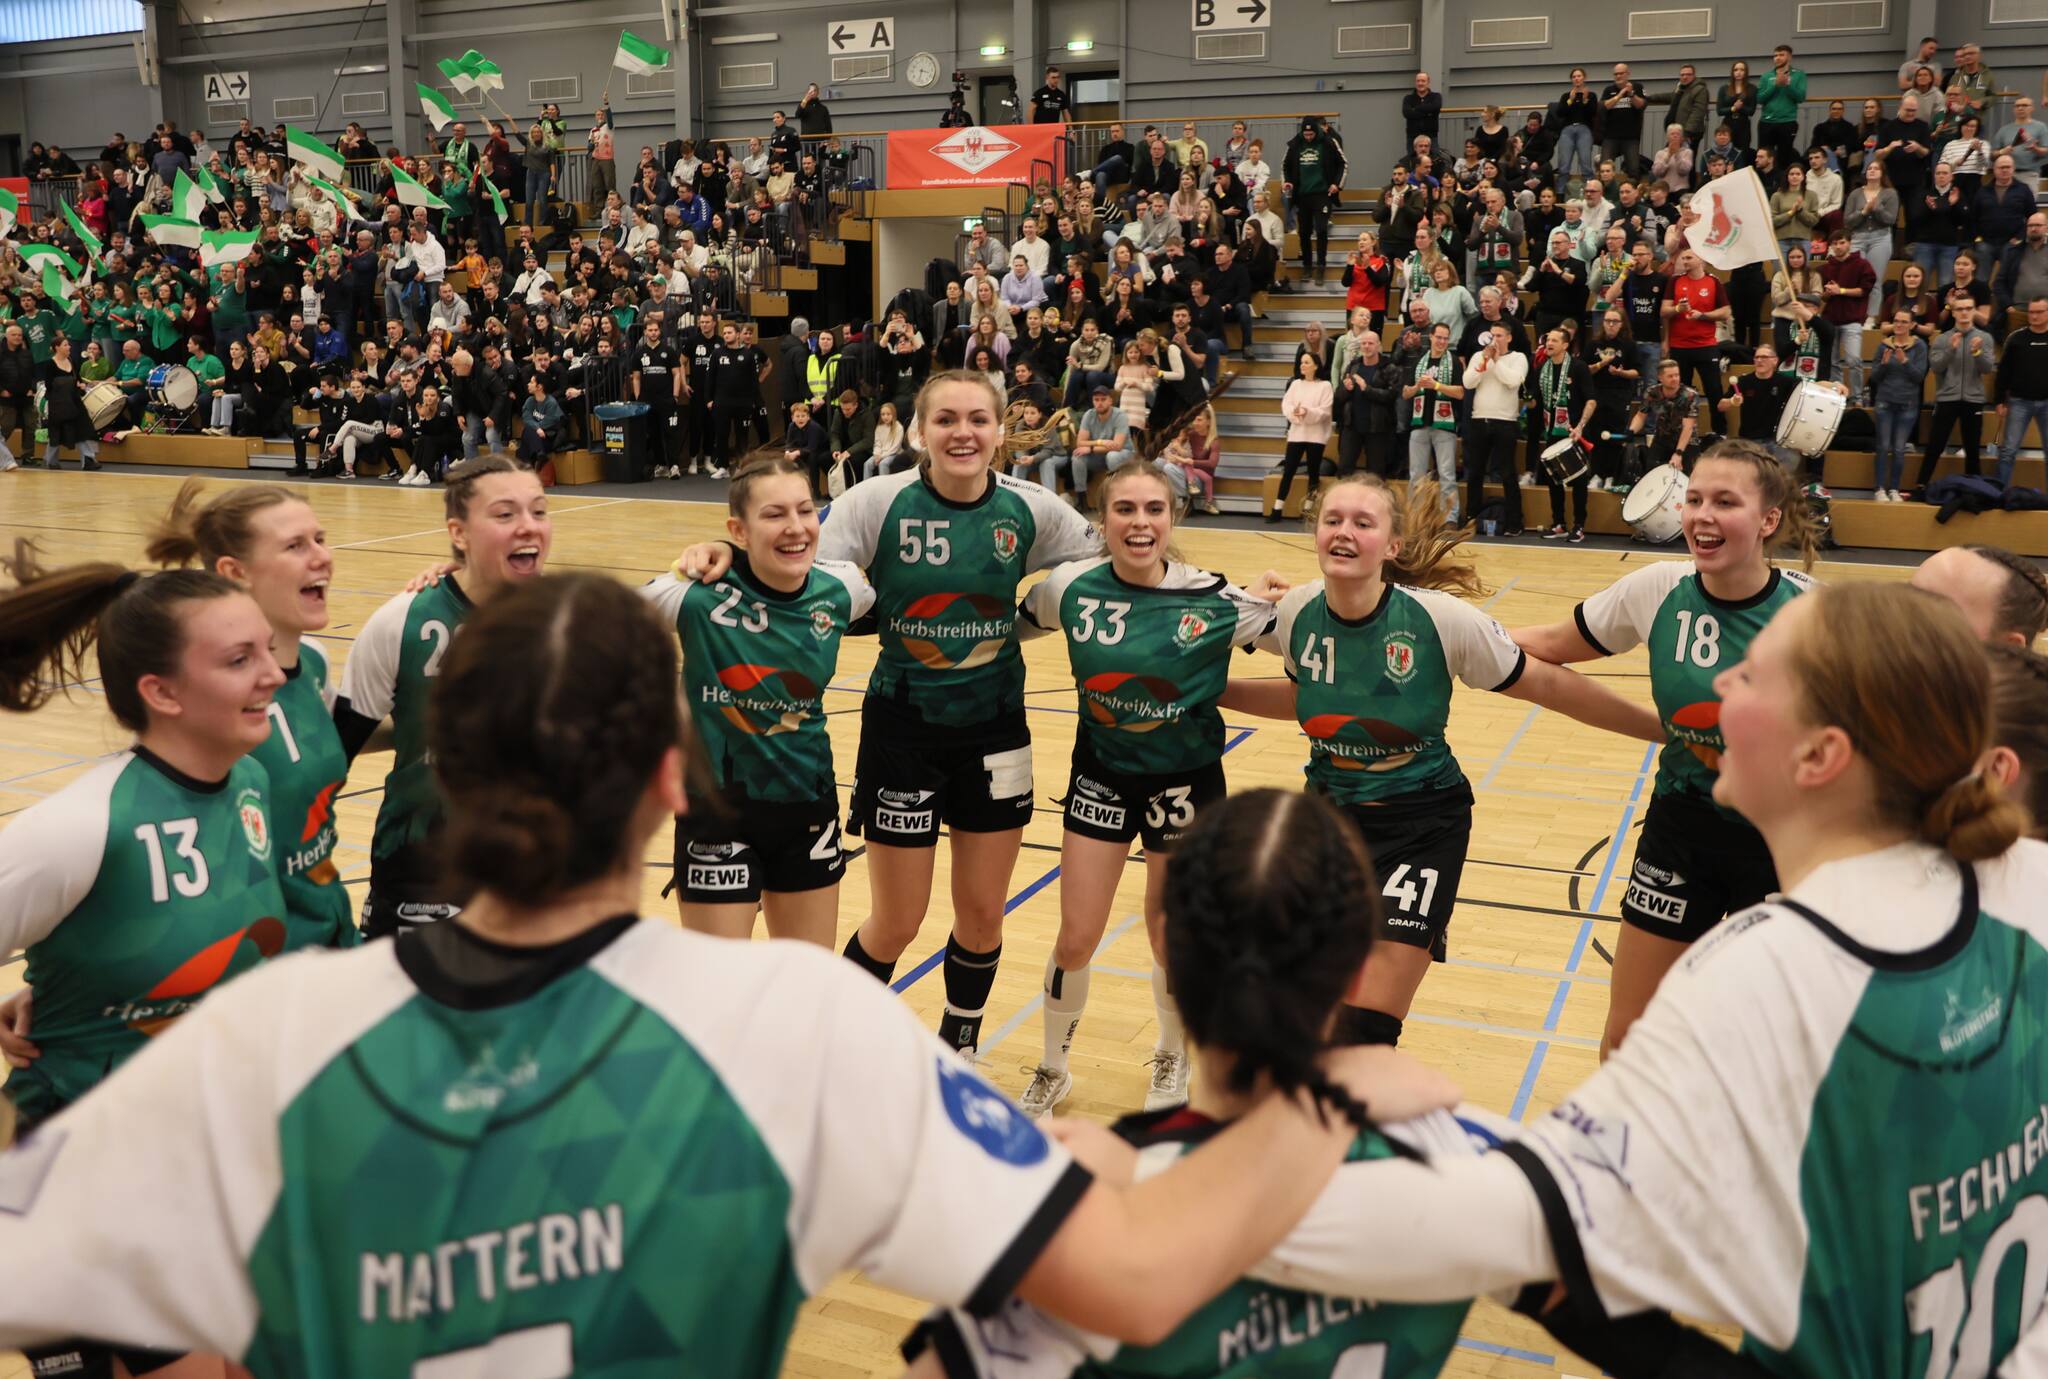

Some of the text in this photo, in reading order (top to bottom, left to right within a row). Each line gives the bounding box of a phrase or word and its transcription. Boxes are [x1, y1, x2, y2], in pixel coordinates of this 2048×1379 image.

[870, 21, 890, 48] A
[1195, 0, 1215, 26] B
[207, 76, 221, 98] A
[899, 518, 951, 566] 55
[709, 582, 769, 633] 23
[1071, 596, 1132, 646] 33
[420, 619, 462, 677] 2
[1300, 632, 1336, 685] 41
[1674, 610, 1721, 668] 18
[879, 811, 930, 829] REWE
[1073, 798, 1122, 826] REWE
[1145, 784, 1195, 829] 33
[134, 816, 210, 903] 13
[690, 868, 746, 886] REWE
[1382, 863, 1439, 917] 41
[1628, 885, 1682, 919] REWE
[1387, 917, 1421, 929] CRAFT
[360, 1203, 623, 1322] MATTERN
